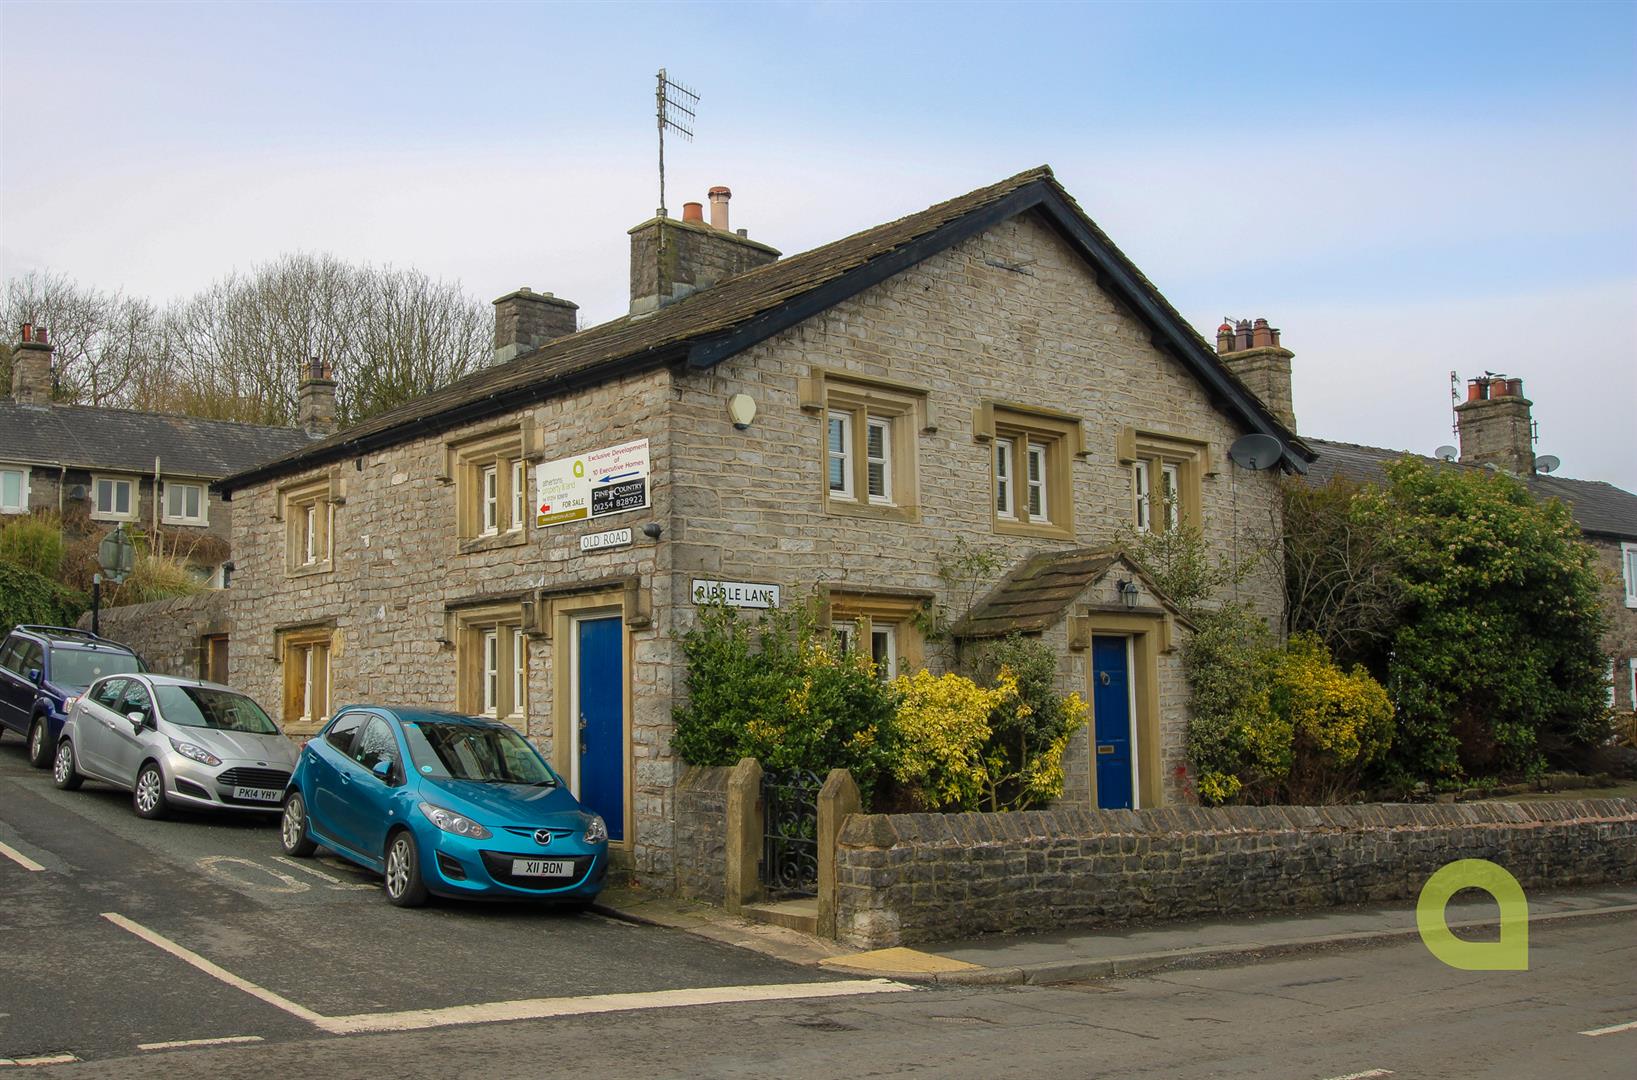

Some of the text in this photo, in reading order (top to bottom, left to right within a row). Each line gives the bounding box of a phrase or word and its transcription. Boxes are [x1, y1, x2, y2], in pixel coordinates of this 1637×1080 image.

[588, 443, 648, 462] Exclusive Development
[600, 464, 624, 475] Executive
[625, 460, 645, 469] Homes
[594, 490, 609, 500] FINE
[614, 483, 643, 496] COUNTRY
[562, 500, 572, 508] FOR
[572, 498, 585, 506] SALE
[593, 501, 613, 512] 01254
[616, 495, 643, 507] 828922
[583, 530, 628, 548] OLD ROAD
[238, 788, 277, 799] PK14 YHY
[526, 862, 563, 874] X11 BON
